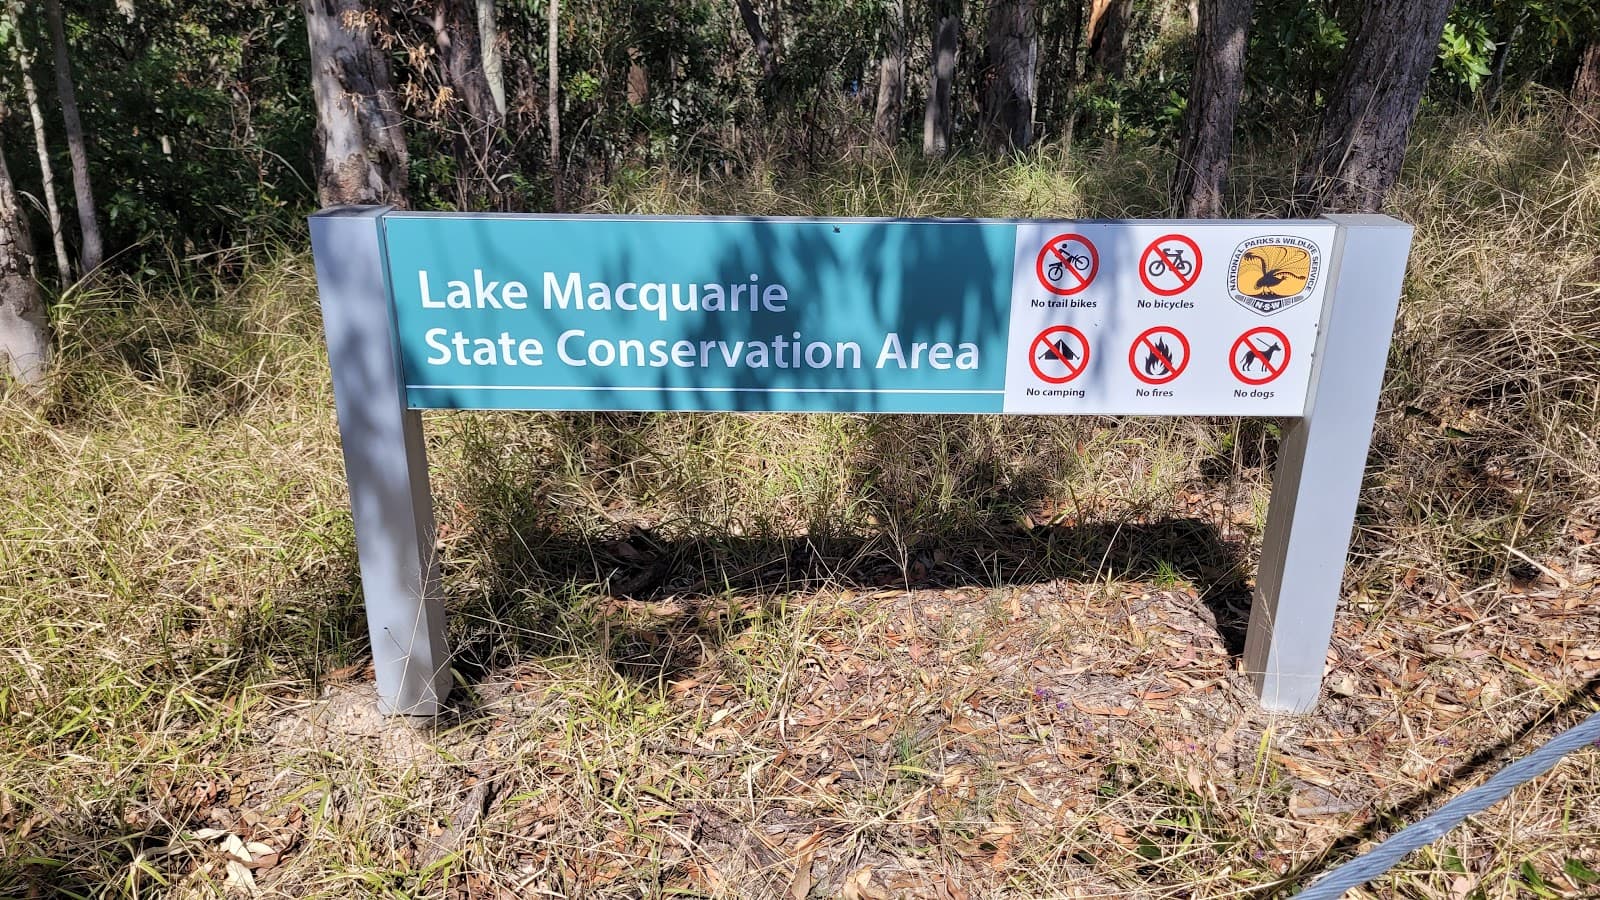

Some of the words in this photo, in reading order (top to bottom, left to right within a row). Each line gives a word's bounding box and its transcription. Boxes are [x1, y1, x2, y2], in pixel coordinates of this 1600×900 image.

[1229, 248, 1245, 292] NATIONAL
[1244, 237, 1275, 249] PARKS
[1282, 237, 1318, 256] WILDLIFE
[1304, 256, 1319, 292] SERVICE
[418, 269, 528, 310] Lake
[543, 271, 788, 321] Macquarie
[1031, 299, 1046, 308] No
[1047, 298, 1069, 308] trail
[1070, 298, 1097, 308] bikes
[1137, 299, 1152, 309] No
[1154, 299, 1195, 311] bicycles
[424, 328, 544, 366] State
[556, 329, 862, 369] Conservation
[875, 332, 980, 371] Area
[1026, 388, 1041, 397] No
[1042, 387, 1085, 399] camping
[1135, 388, 1150, 398] No
[1152, 388, 1174, 398] fires
[1233, 389, 1248, 398] No
[1249, 389, 1275, 400] dogs
